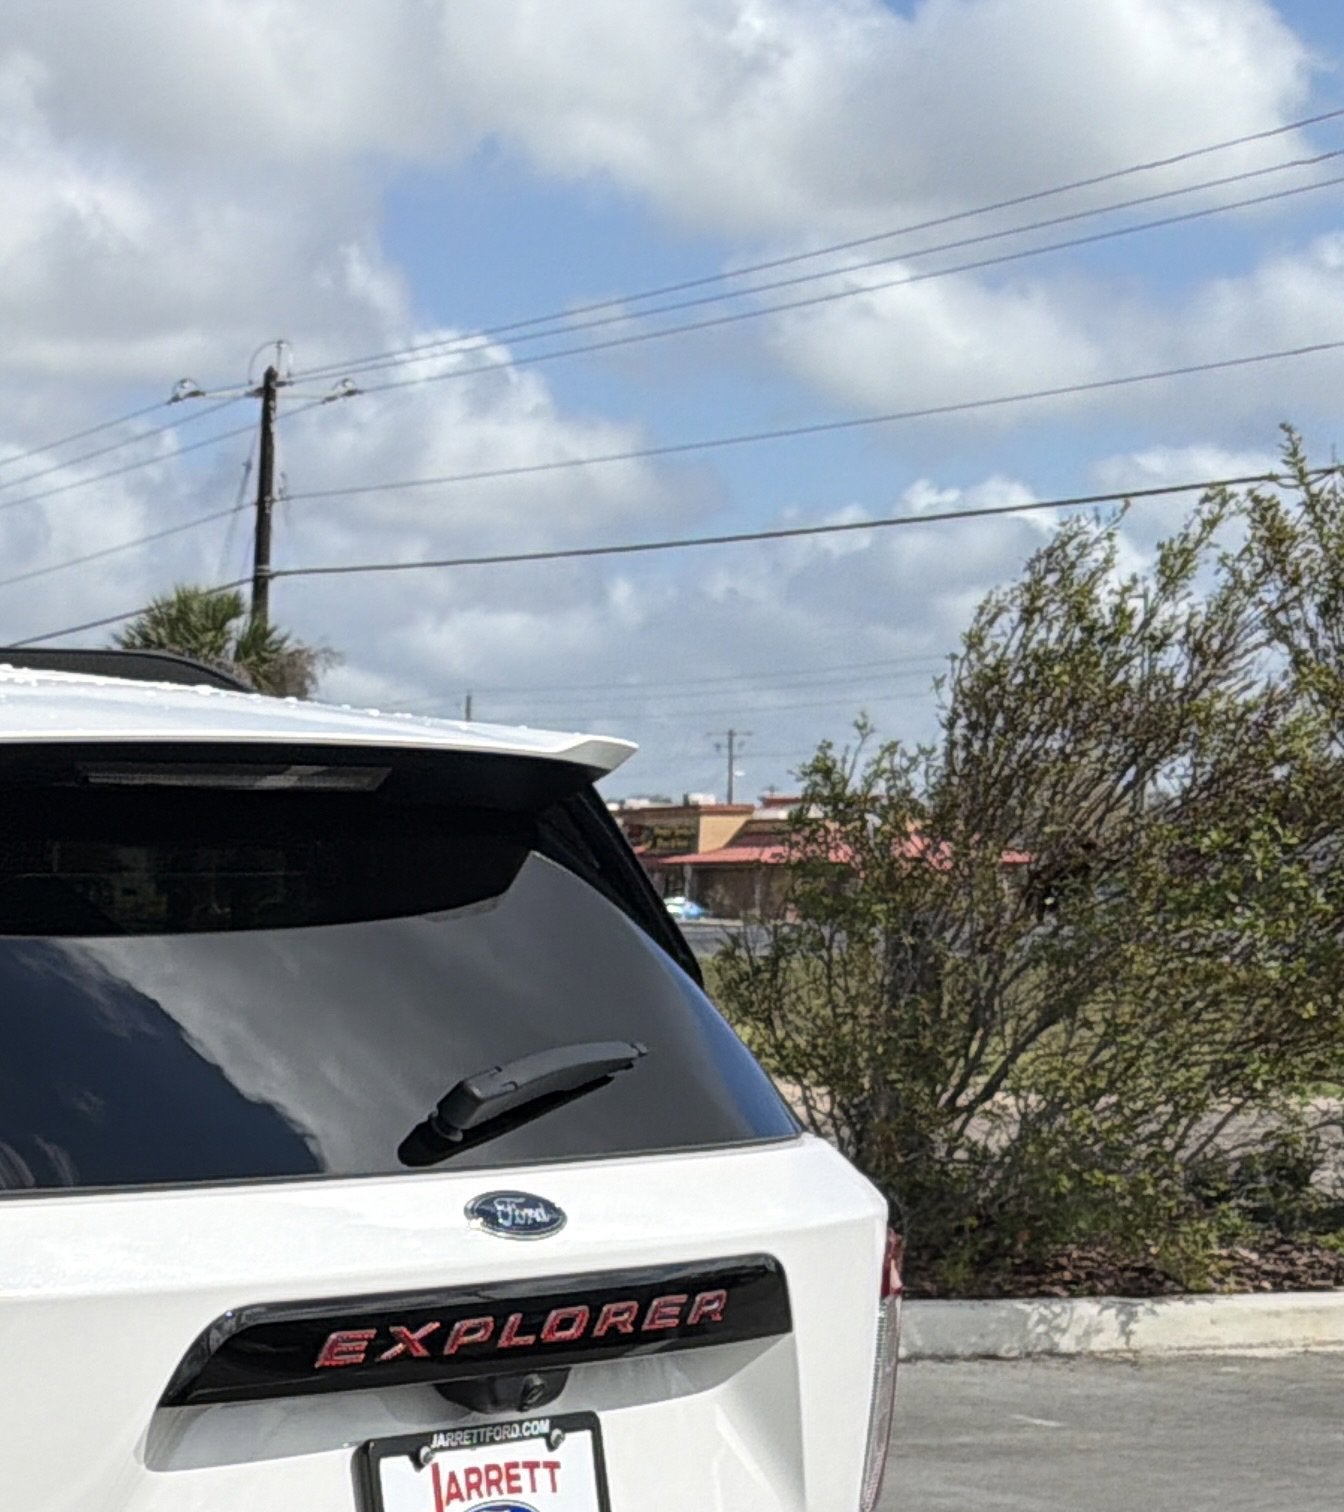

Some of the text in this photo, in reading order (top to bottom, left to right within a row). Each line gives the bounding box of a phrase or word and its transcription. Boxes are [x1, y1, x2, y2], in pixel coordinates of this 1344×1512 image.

[493, 1198, 550, 1226] Ford
[315, 1289, 728, 1368] EXPLORER
[430, 1418, 550, 1449] JARRETTFORD.COM
